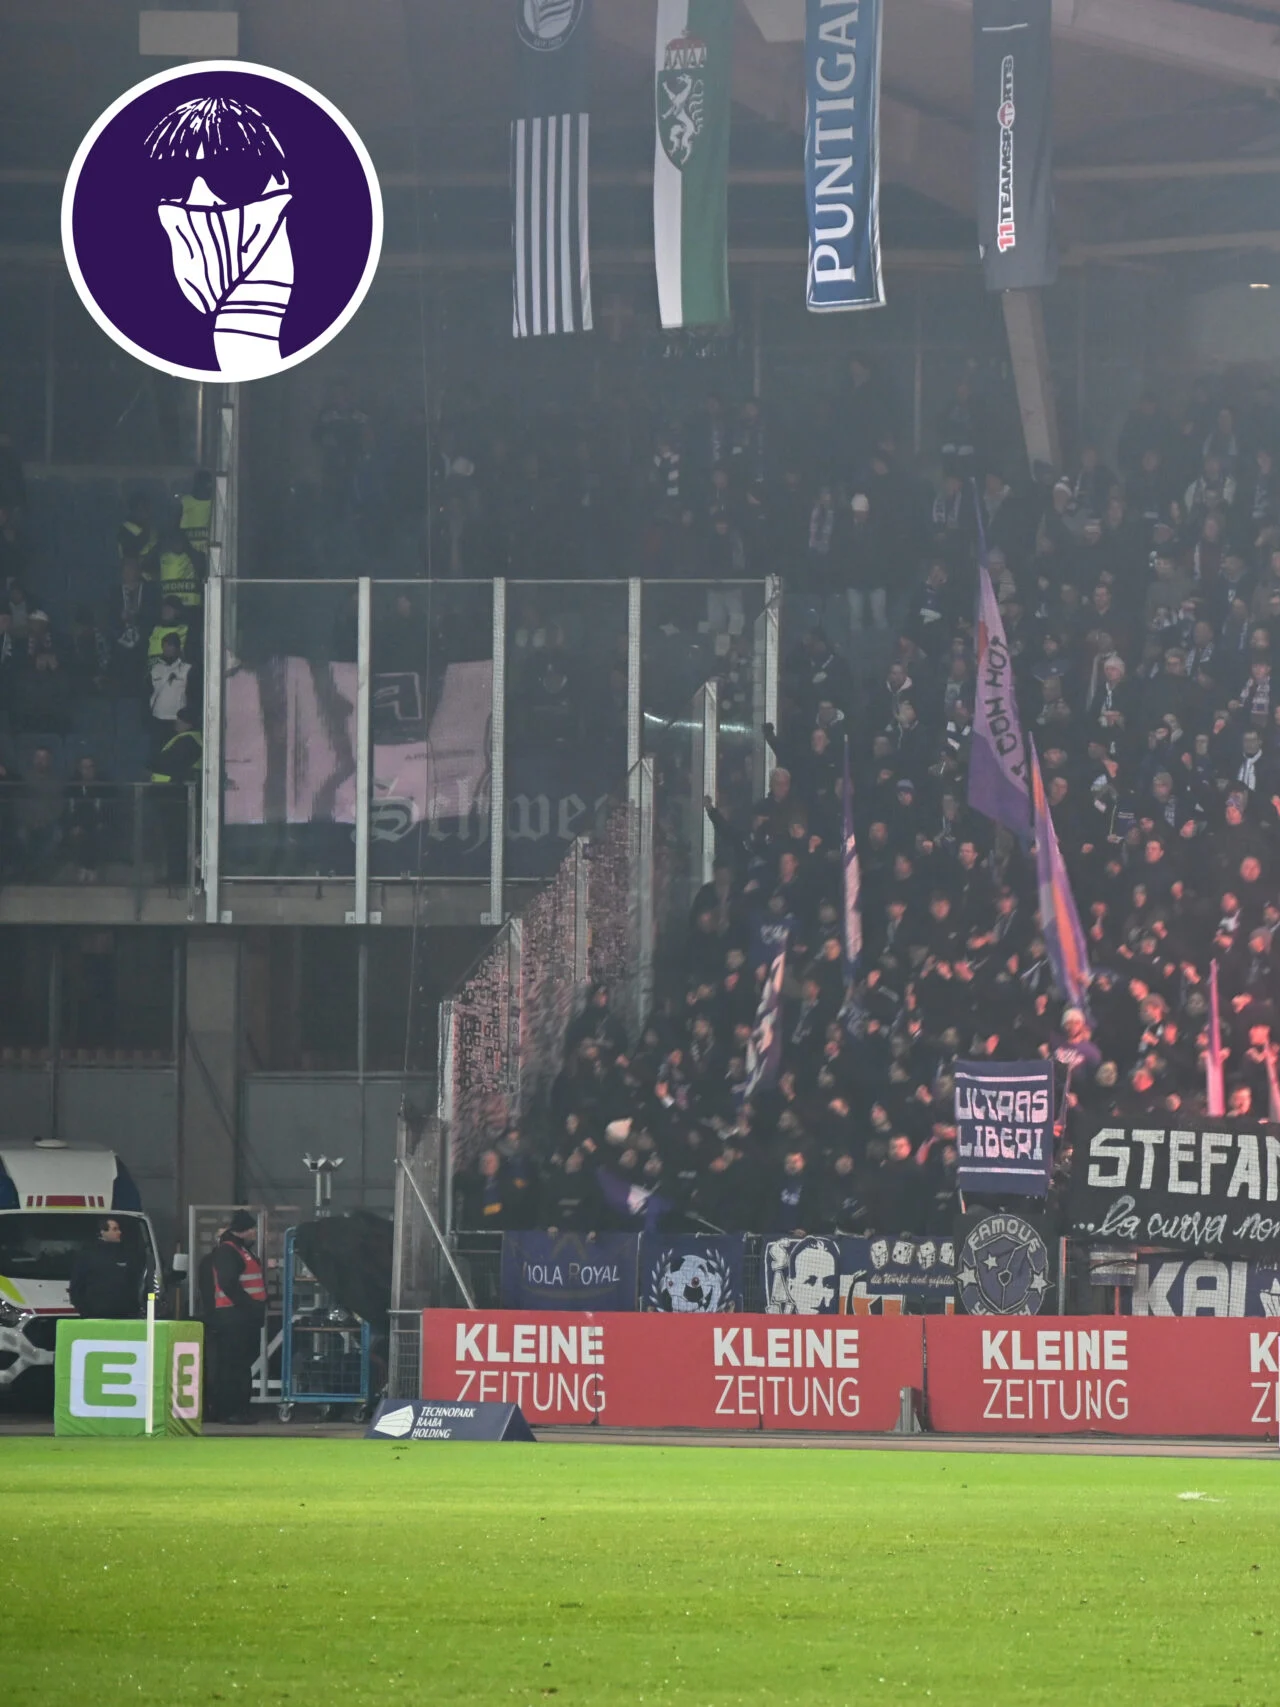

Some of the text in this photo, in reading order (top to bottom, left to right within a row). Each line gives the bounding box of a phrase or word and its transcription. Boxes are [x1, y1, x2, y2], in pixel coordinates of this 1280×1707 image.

[955, 1087, 1048, 1123] ULTRAS
[957, 1125, 1043, 1160] LIBERI
[967, 1218, 1041, 1253] FAMOUS
[456, 1323, 605, 1365] KLEINE
[713, 1328, 860, 1368] KLEINE
[982, 1330, 1128, 1370] KLEINE
[455, 1370, 606, 1413] ZEITUNG
[714, 1375, 860, 1417] ZEITUNG
[983, 1379, 1129, 1420] ZEITUNG
[416, 1417, 442, 1426] RAABA
[420, 1406, 476, 1418] TECHNOPARK
[411, 1428, 452, 1439] HOLDING
